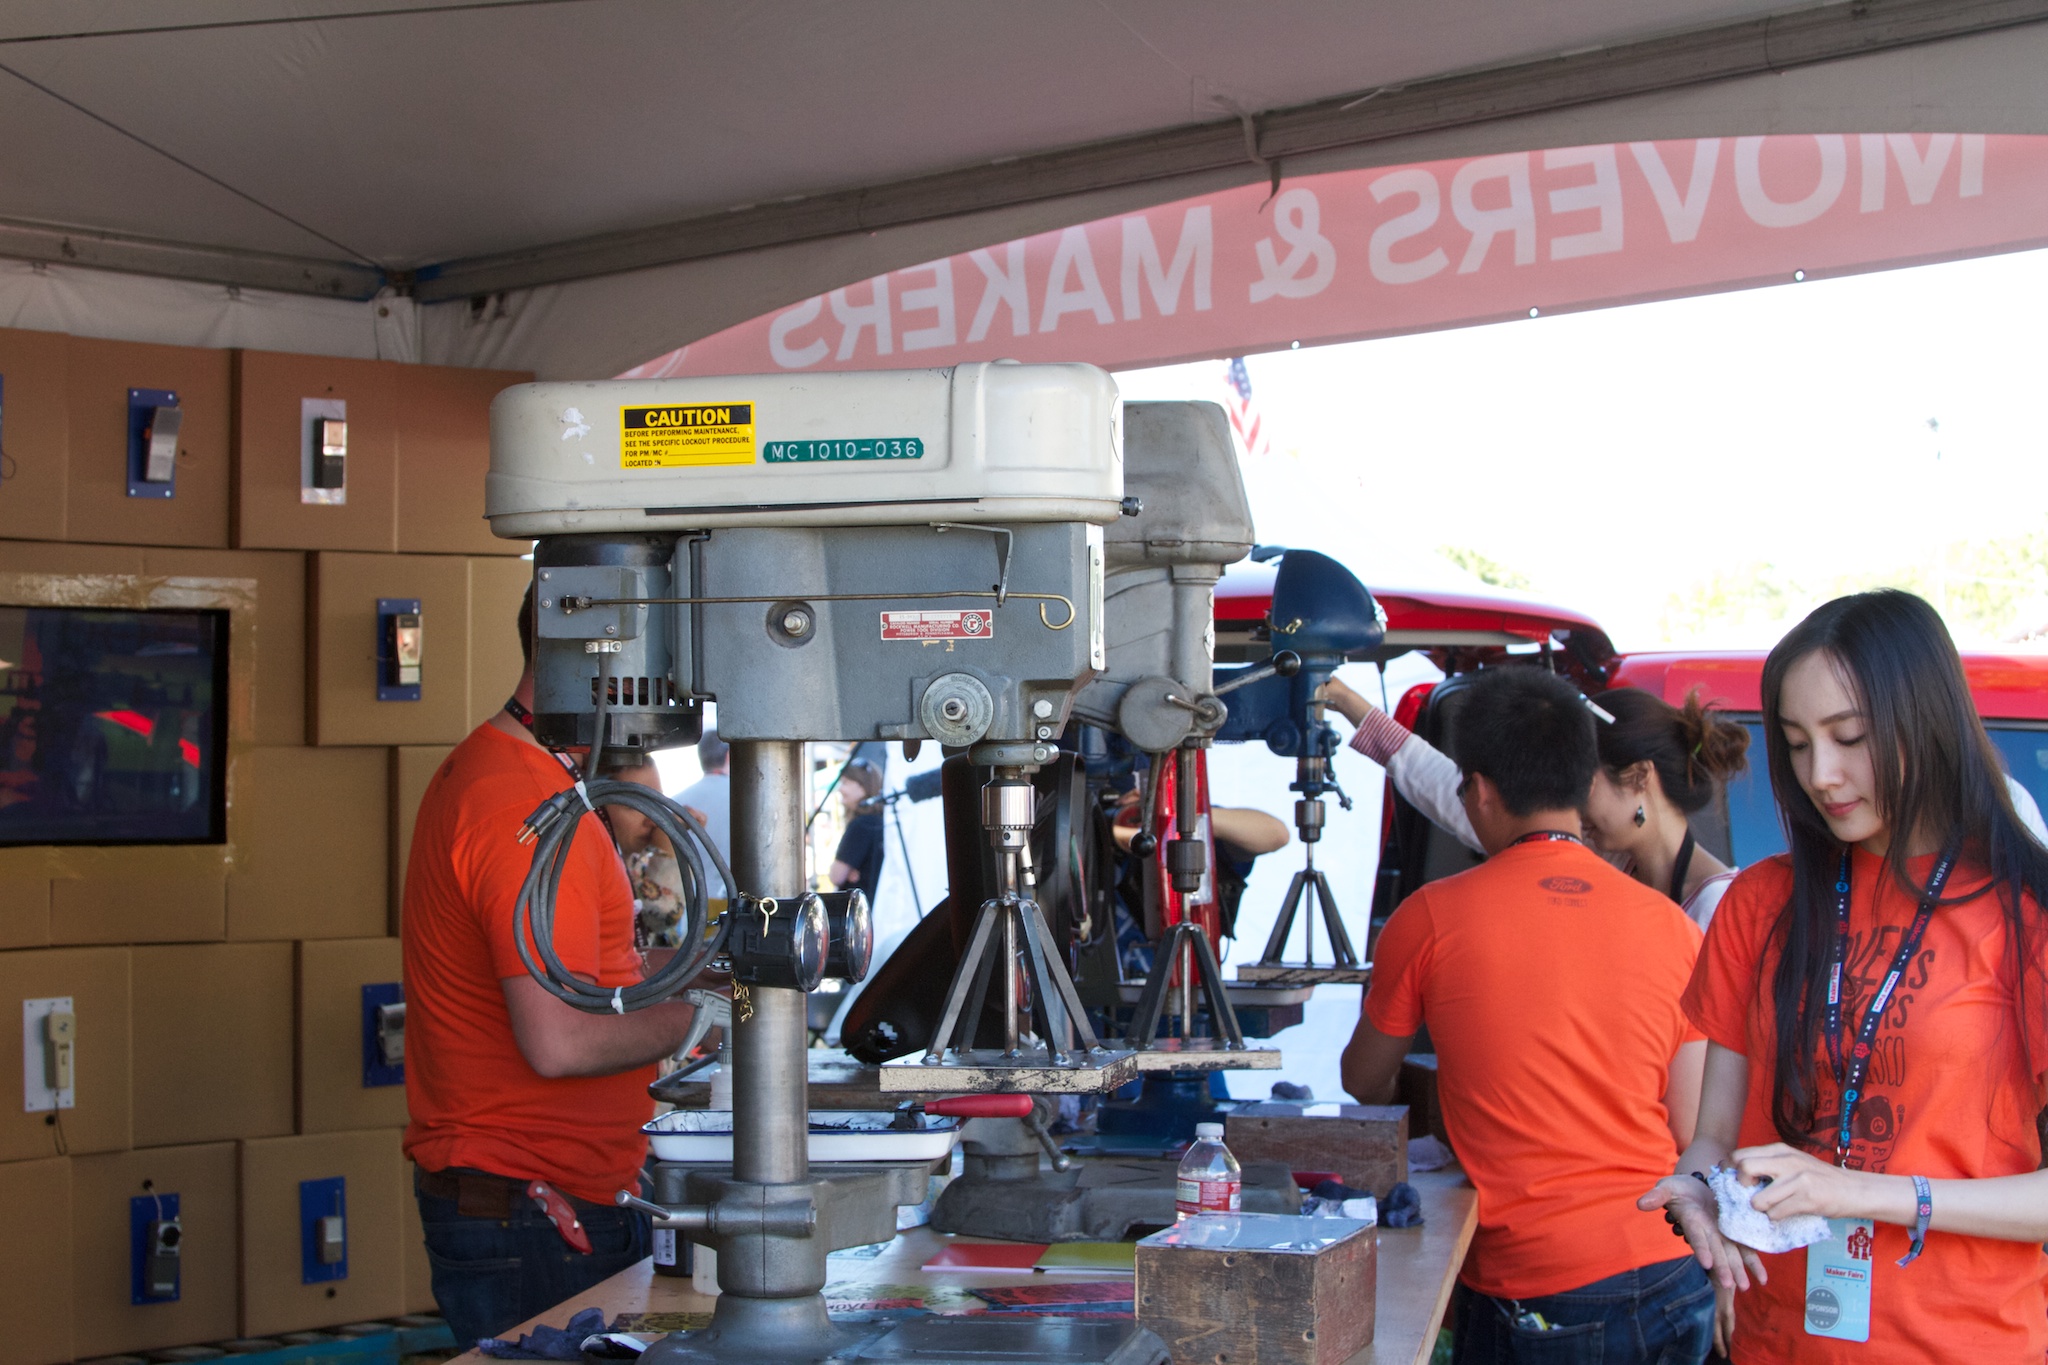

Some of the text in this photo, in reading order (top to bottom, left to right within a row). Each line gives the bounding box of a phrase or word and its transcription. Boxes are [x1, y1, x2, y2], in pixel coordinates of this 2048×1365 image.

[645, 408, 731, 427] CAUTION
[651, 429, 692, 437] PERFORMING
[694, 427, 740, 435] MAINTENANCE,
[652, 438, 681, 446] SPECIFIC
[712, 436, 750, 444] PROCEDURE
[771, 440, 917, 459] MC 1010-036
[1932, 861, 1948, 886] MEDIA
[1886, 973, 1898, 992] Maker
[1829, 983, 1837, 1002] Maker
[1826, 1267, 1864, 1279] Maker Faire
[1807, 1303, 1839, 1314] SPONSOR
